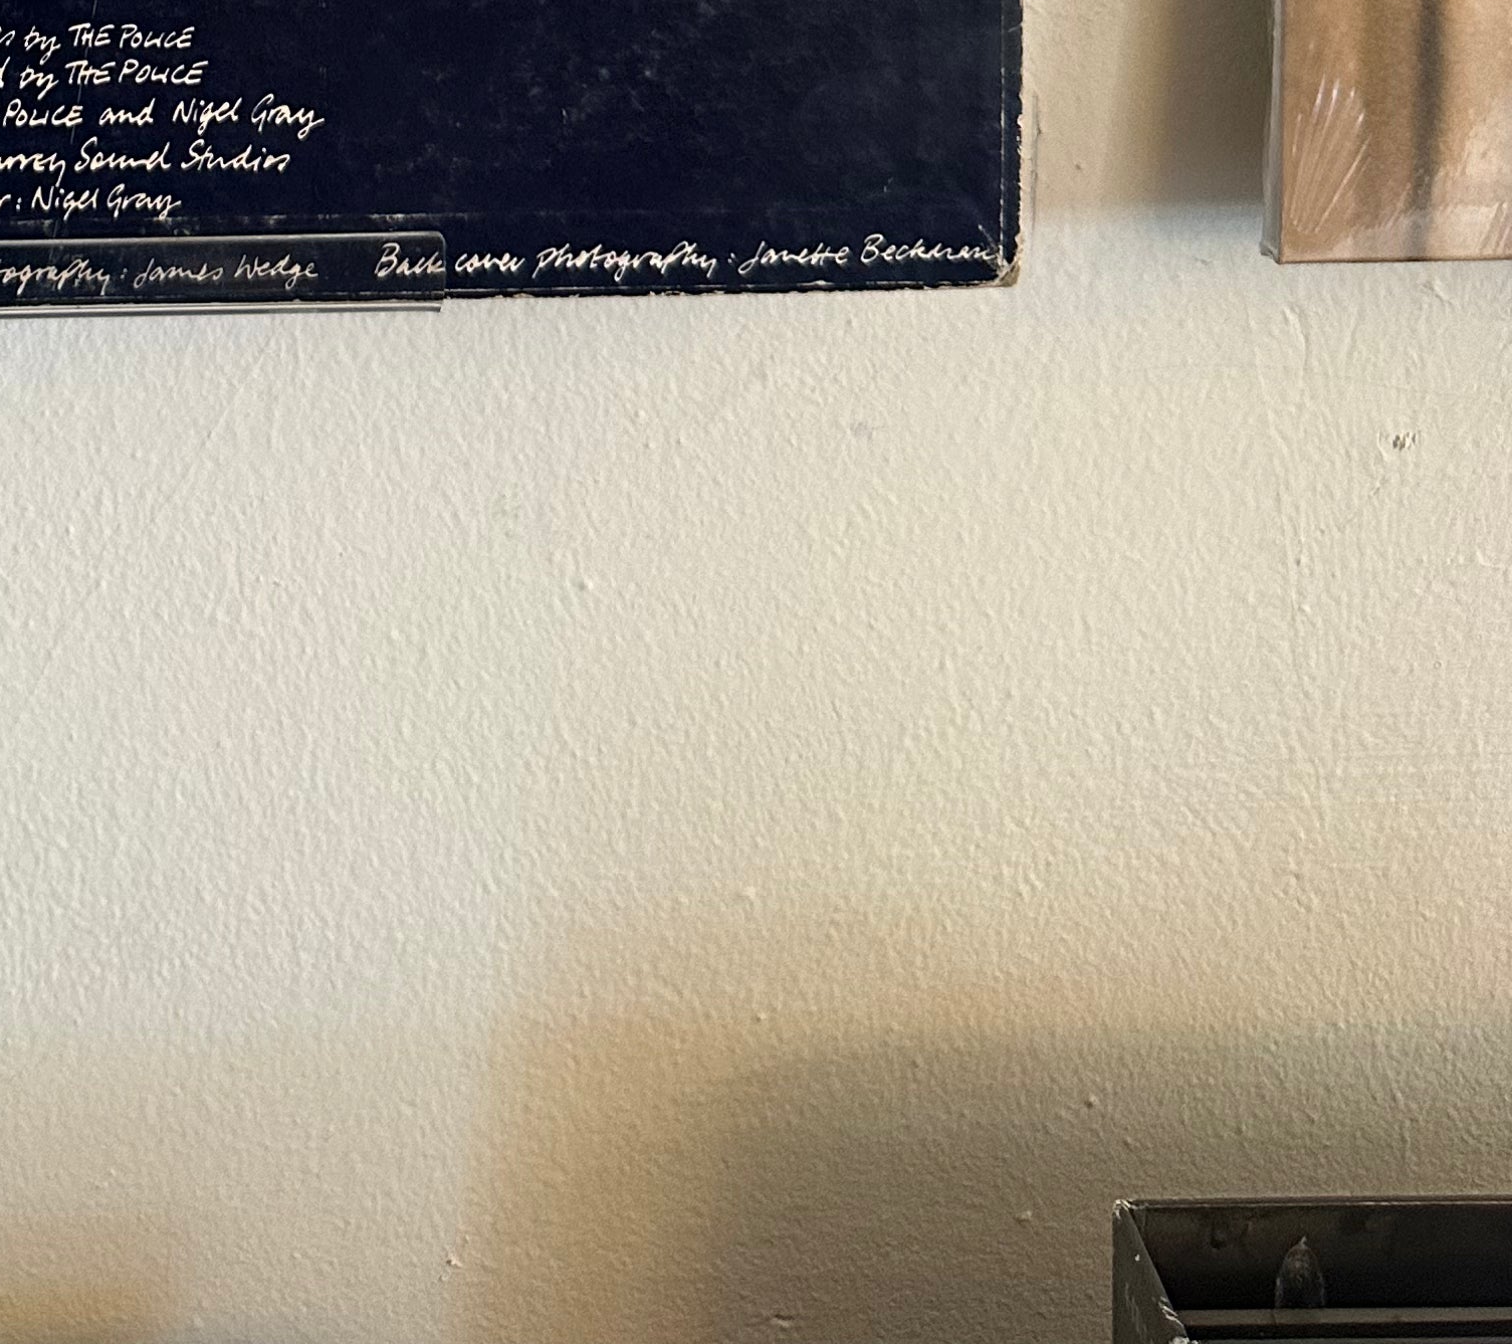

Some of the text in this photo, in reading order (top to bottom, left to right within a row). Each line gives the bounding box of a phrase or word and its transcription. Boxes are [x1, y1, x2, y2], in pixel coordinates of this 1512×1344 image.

[23, 25, 62, 65] by
[67, 23, 115, 49] THE
[19, 65, 59, 101] by
[64, 60, 116, 85] THE
[98, 97, 156, 127] and
[172, 97, 243, 136] Nigel
[250, 93, 325, 140] Gray
[74, 136, 171, 172] Sound
[181, 138, 291, 173] Studios
[31, 185, 100, 221] Nigel
[106, 183, 182, 221] Gray
[133, 258, 224, 289] James
[234, 253, 319, 290] Wedge
[374, 241, 445, 278] Back
[454, 252, 526, 273] cover
[737, 241, 850, 273] Janette
